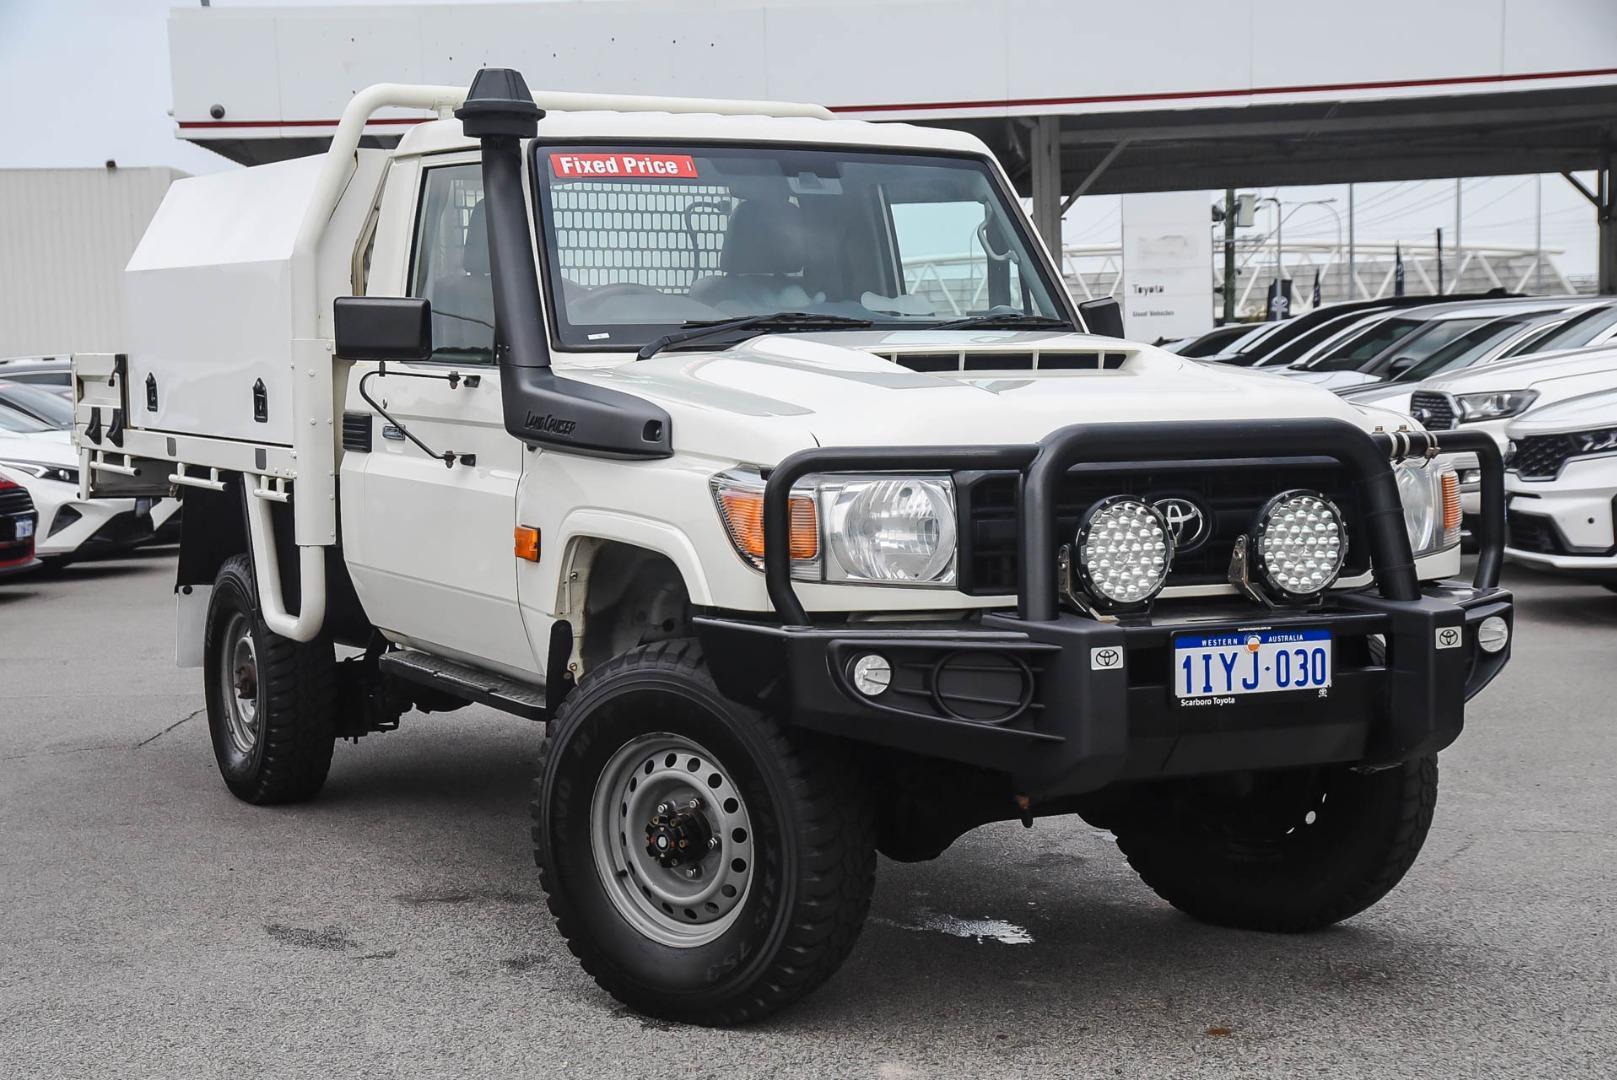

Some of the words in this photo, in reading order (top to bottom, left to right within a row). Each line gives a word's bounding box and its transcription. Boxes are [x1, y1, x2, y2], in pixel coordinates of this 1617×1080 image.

[559, 156, 619, 174] Fixed
[622, 157, 679, 174] Price
[1132, 283, 1165, 297] Toyota
[1201, 638, 1238, 647] WESTERN
[1268, 634, 1304, 643] AUSTRALIA
[1180, 698, 1212, 707] Scarboro
[1212, 697, 1236, 706] Toyota
